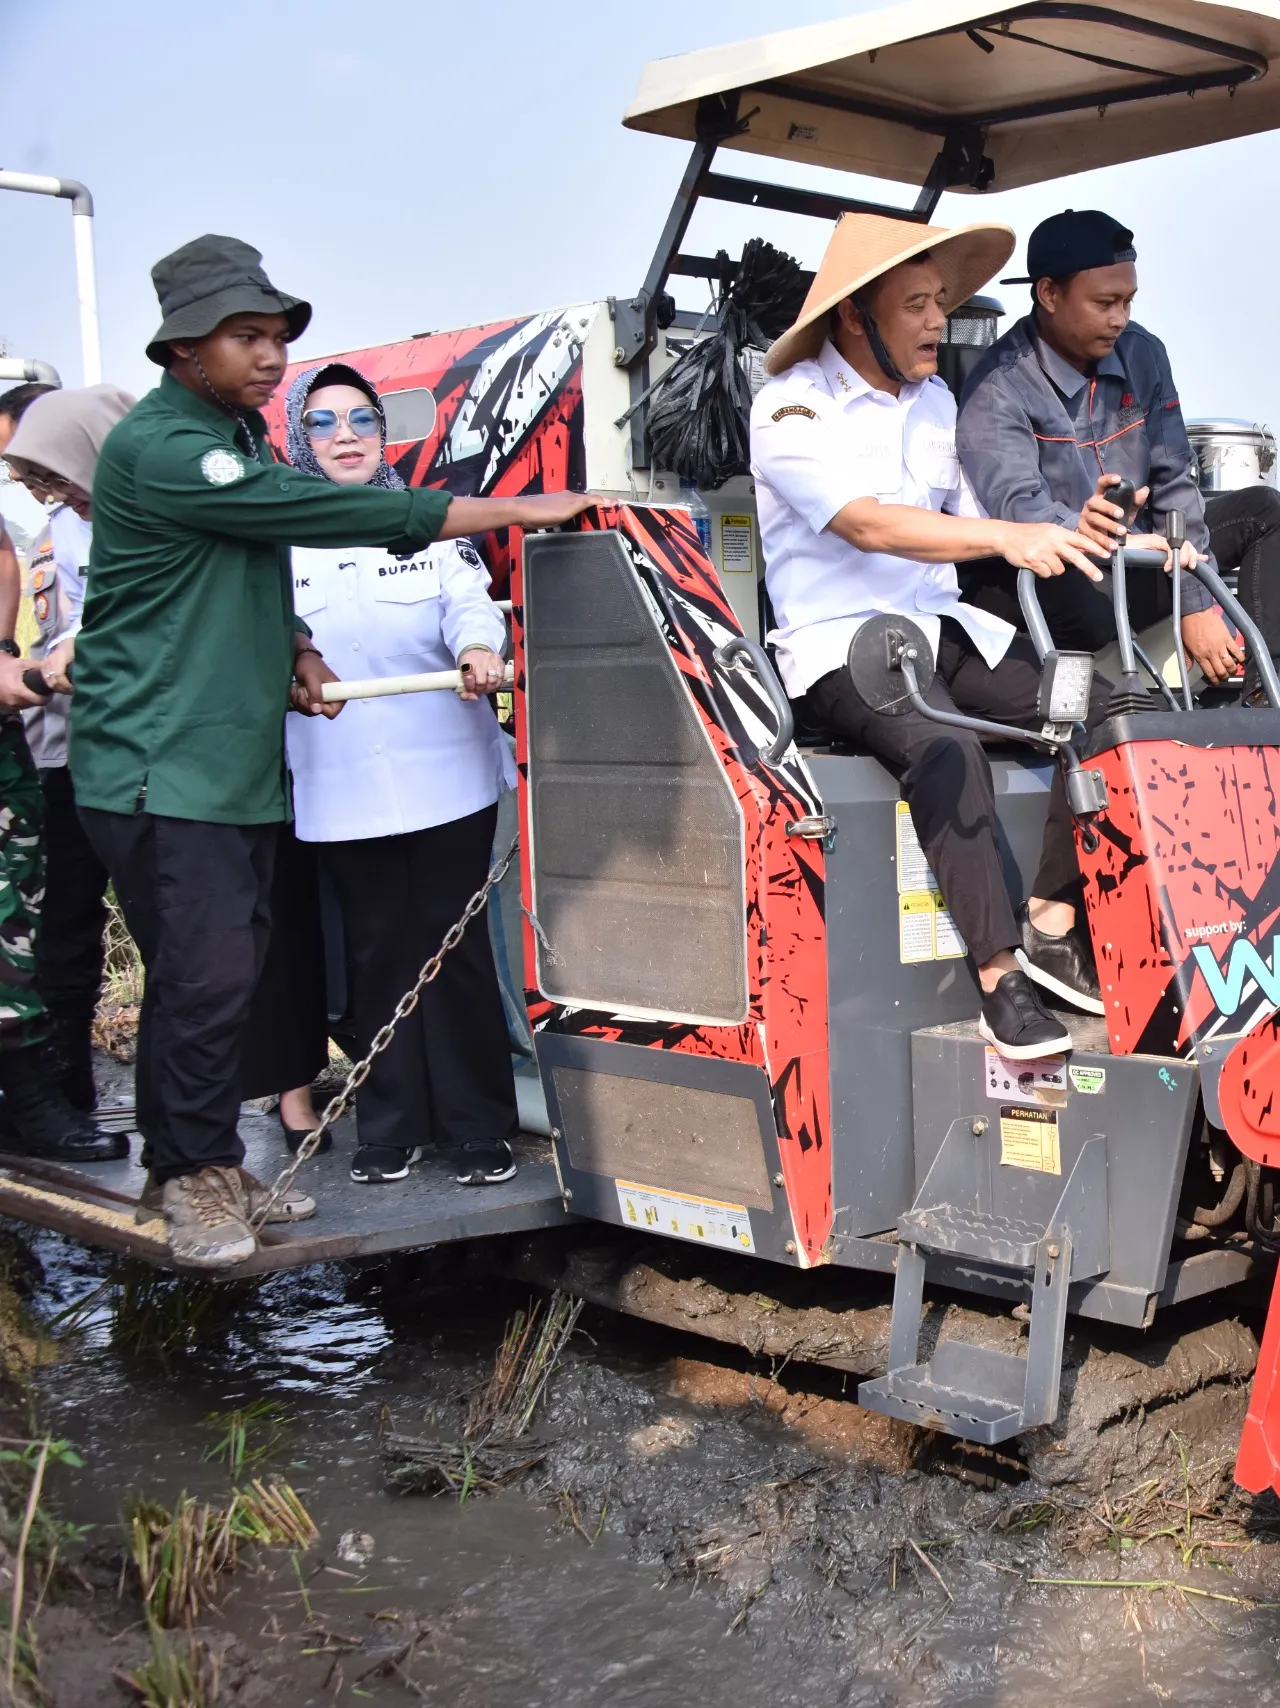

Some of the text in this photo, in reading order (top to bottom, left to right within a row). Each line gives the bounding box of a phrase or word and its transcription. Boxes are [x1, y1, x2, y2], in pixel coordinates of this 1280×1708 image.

[378, 560, 433, 577] BUPATI
[295, 577, 311, 588] IK
[1184, 920, 1247, 939] support by:
[1011, 1109, 1048, 1120] PERHATIAN
